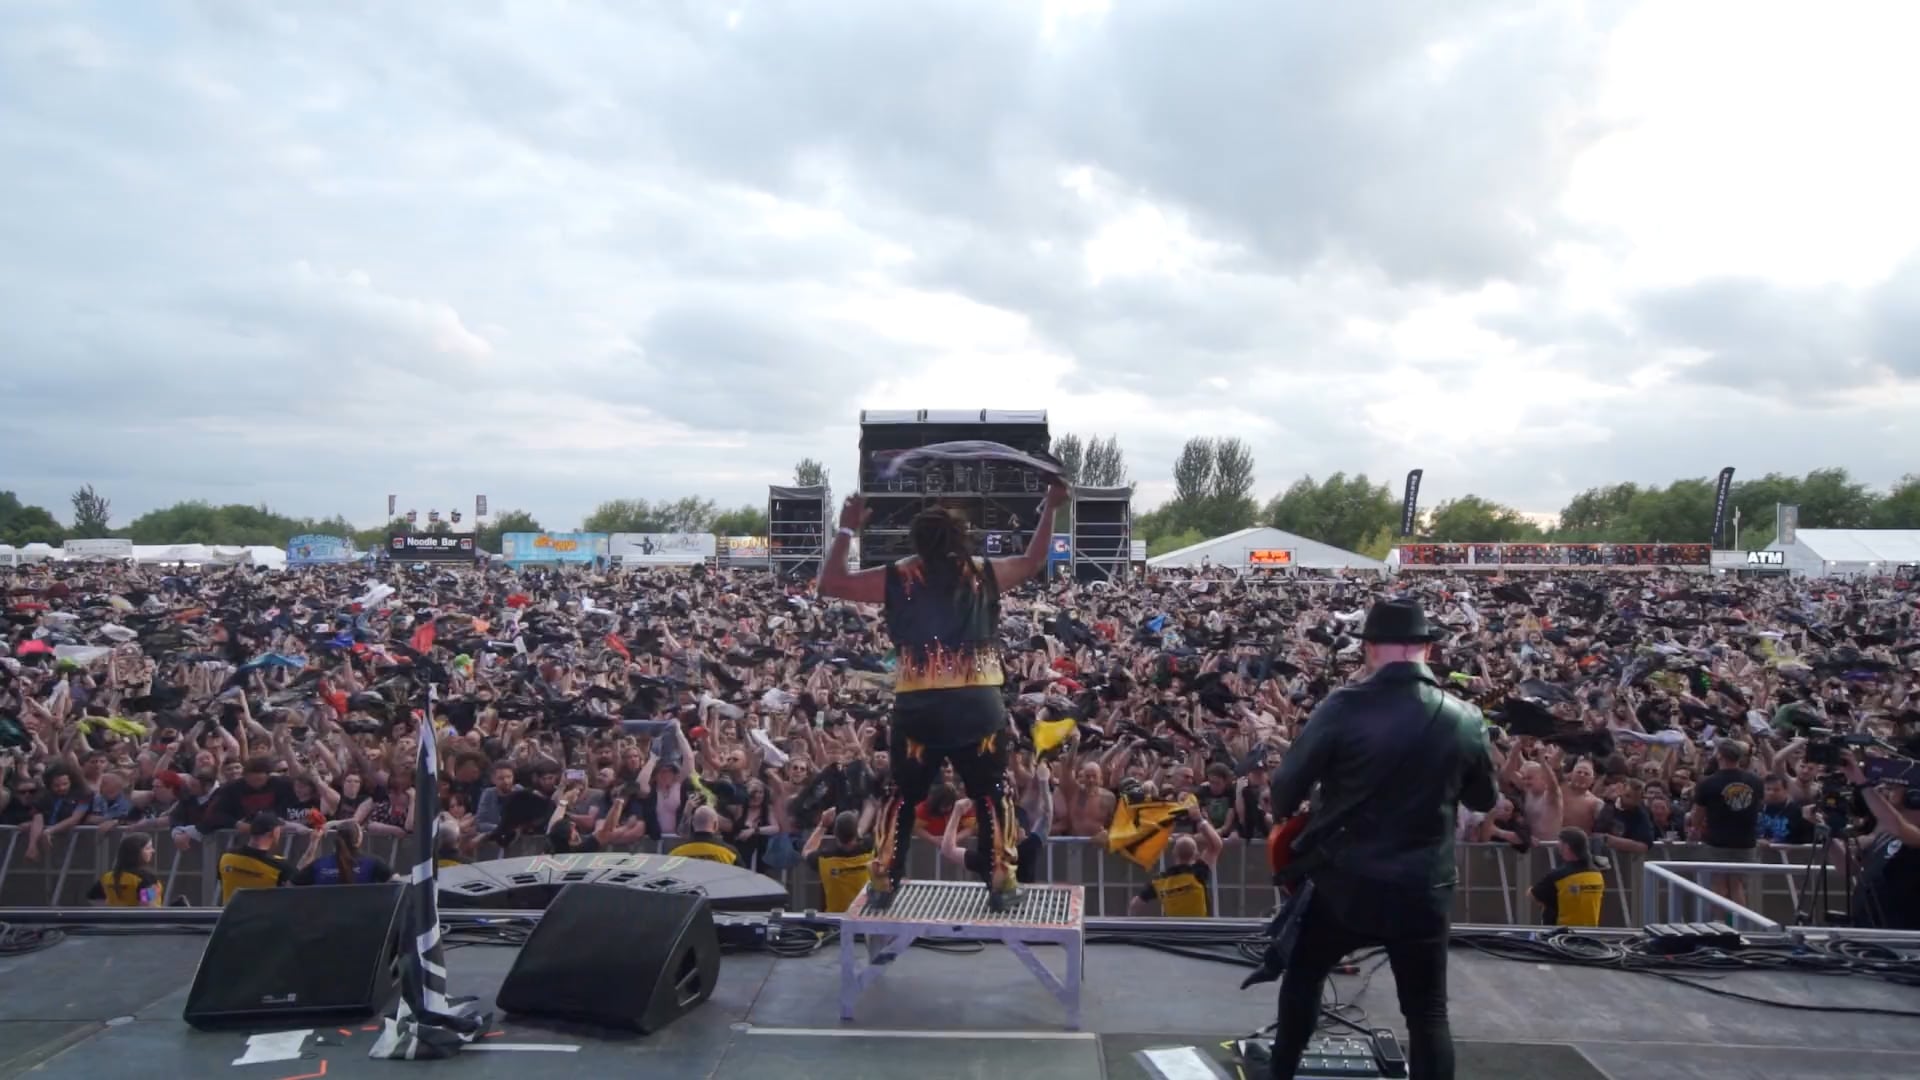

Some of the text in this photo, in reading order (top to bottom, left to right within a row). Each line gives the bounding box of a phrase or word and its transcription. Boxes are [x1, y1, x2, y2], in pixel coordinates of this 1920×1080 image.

[406, 537, 438, 547] Noodle
[441, 537, 458, 547] Bar
[1747, 551, 1783, 564] ATM
